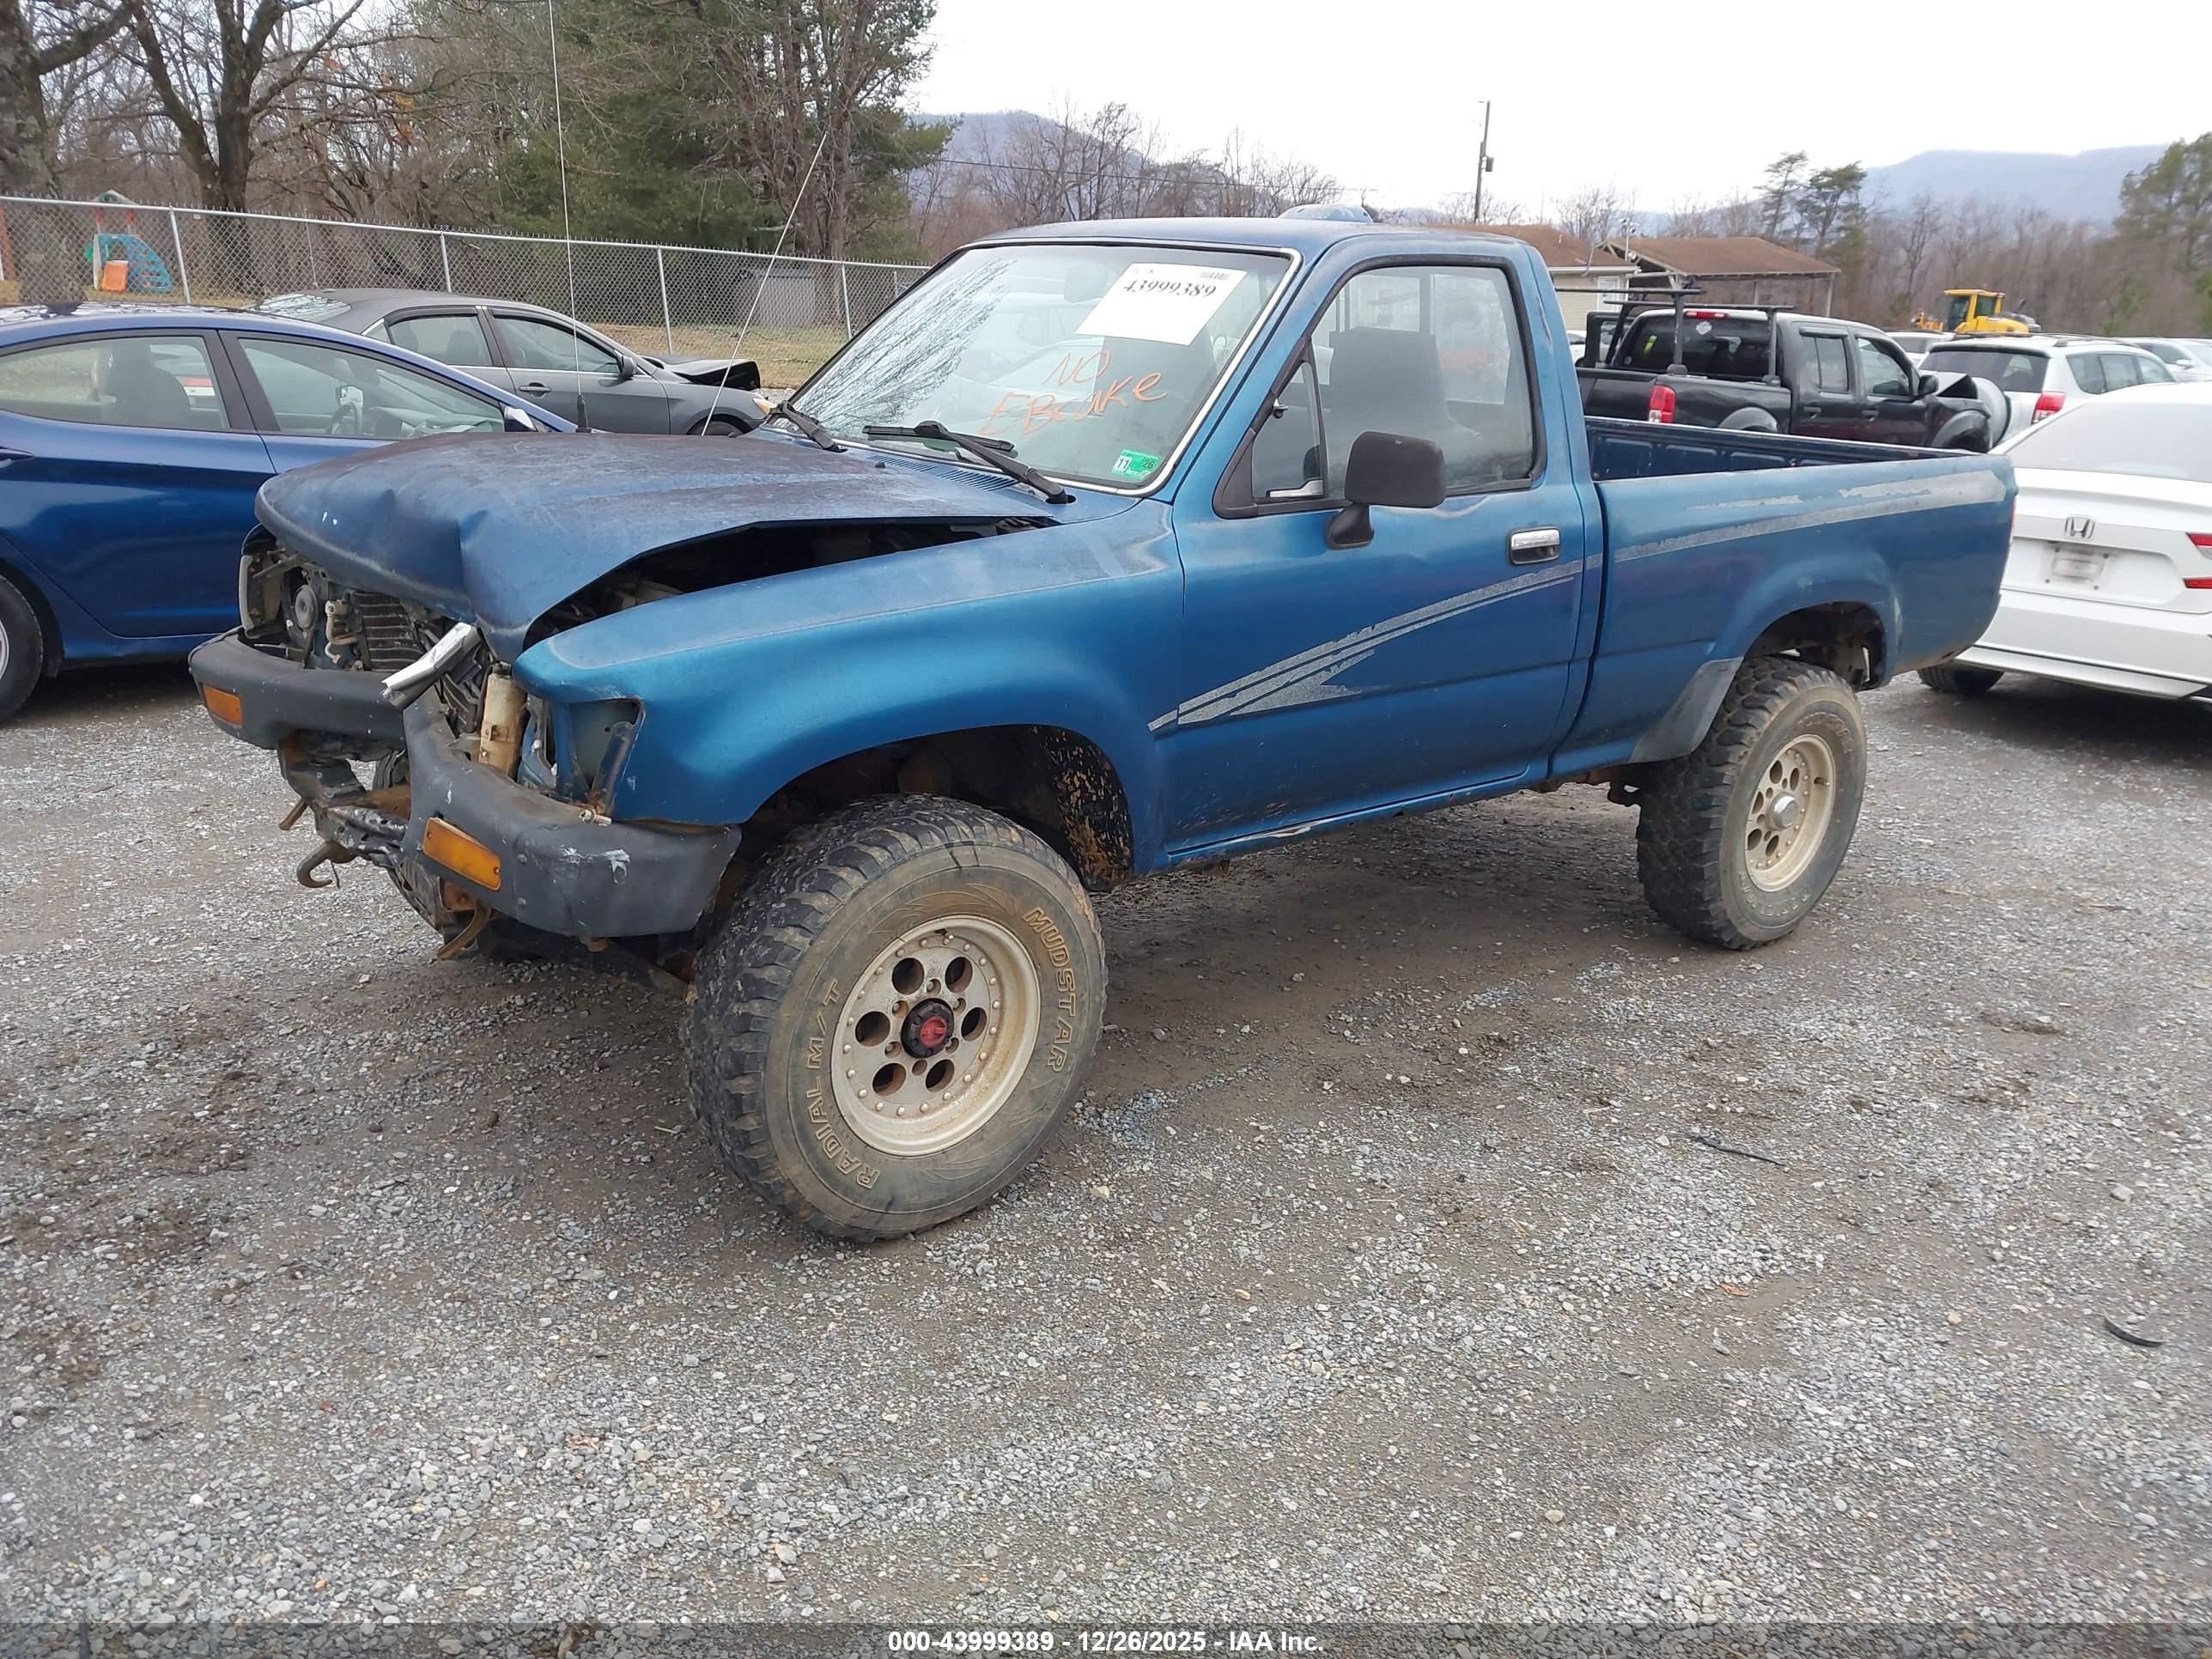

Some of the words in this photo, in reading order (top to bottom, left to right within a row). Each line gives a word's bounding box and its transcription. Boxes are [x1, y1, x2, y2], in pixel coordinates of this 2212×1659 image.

[1123, 279, 1217, 297] 43999389
[1117, 459, 1130, 469] 11
[805, 979, 841, 1070] M/T
[1022, 906, 1077, 1073] MUDSTAR
[805, 1076, 880, 1189] RADIAL
